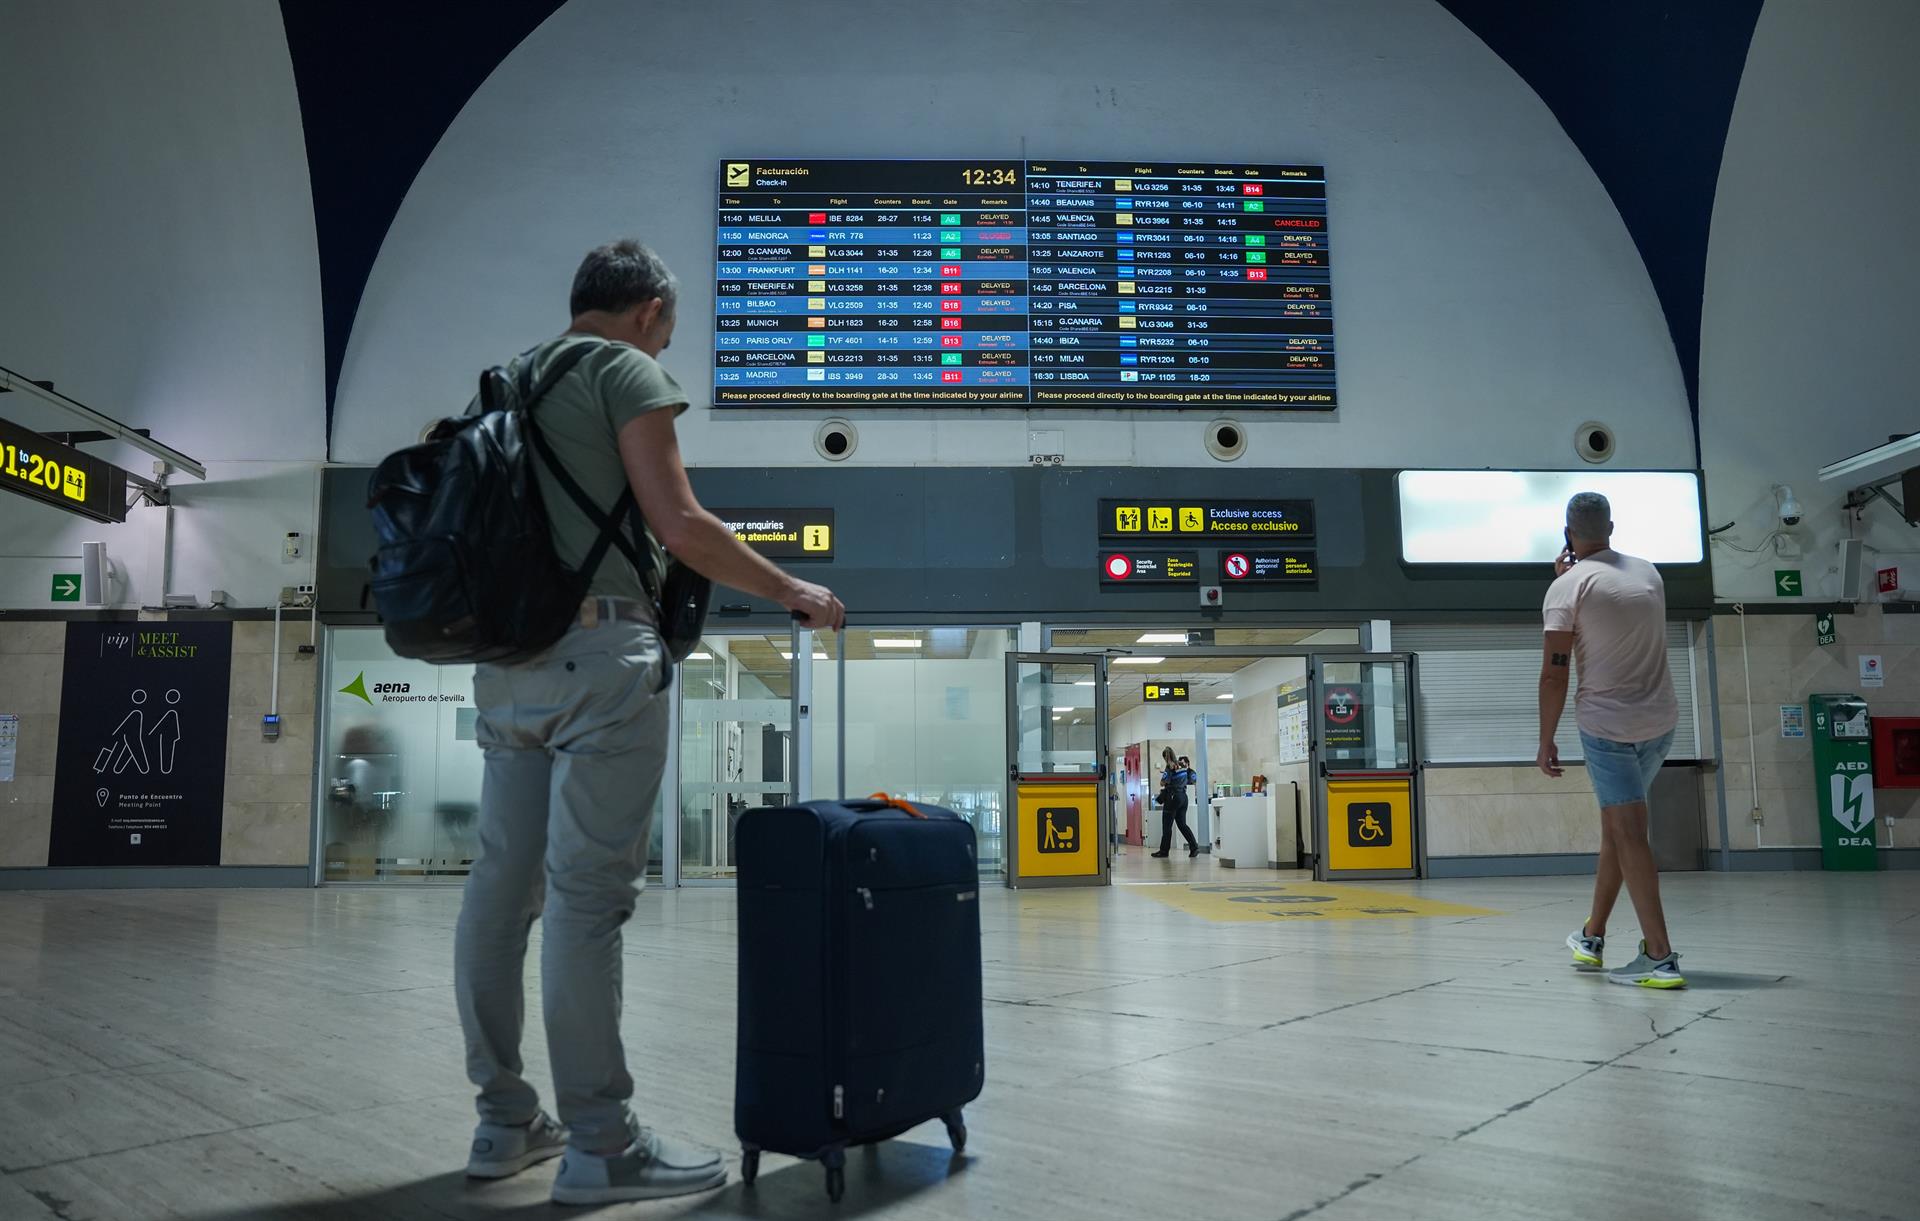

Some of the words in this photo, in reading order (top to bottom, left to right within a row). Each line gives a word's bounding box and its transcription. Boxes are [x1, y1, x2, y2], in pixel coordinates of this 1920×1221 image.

[756, 166, 809, 176] Facturación
[962, 169, 1017, 186] 12:34
[1056, 180, 1102, 188] TENERIFE.N
[829, 198, 848, 206] Flight
[1056, 199, 1095, 207] BEAUVAIS
[1056, 214, 1095, 222] VALENCIA
[748, 232, 789, 240] MENORCA
[828, 232, 846, 240] RYR
[1057, 233, 1098, 241] SANTIAGO
[747, 247, 792, 255] G.CANARIA
[1057, 250, 1104, 258] LANZAROTE
[943, 267, 957, 275] B11
[1057, 267, 1096, 275] VALENCIA
[747, 282, 794, 290] TENERIFE.N
[828, 284, 845, 292] VLG
[1058, 283, 1107, 291] BARCELONA
[1058, 302, 1078, 310] PISA
[1059, 337, 1080, 345] IBIZA
[746, 353, 796, 361] BARCELONA
[1059, 355, 1084, 363] MILAN
[944, 373, 959, 381] B11
[1140, 373, 1155, 381] TAP
[749, 392, 780, 401] proceed
[782, 392, 811, 400] directly
[836, 392, 870, 400] boarding
[871, 392, 889, 400] gate
[968, 392, 978, 400] by
[1037, 391, 1063, 399] Please
[1064, 392, 1095, 400] proceed
[1096, 392, 1125, 400] directly
[1149, 392, 1183, 401] boarding
[1185, 393, 1201, 402] gate
[1243, 393, 1278, 401] indicated
[1278, 393, 1288, 402] by
[1289, 394, 1307, 402] your
[1307, 393, 1331, 401] airline
[19, 449, 29, 463] to
[20, 469, 27, 480] a
[28, 454, 61, 490] 20
[1210, 508, 1250, 519] Exclusive
[1252, 510, 1282, 519] access
[746, 520, 784, 531] enquiries
[1210, 521, 1249, 531] Acceso
[1251, 520, 1299, 531] exclusivo
[747, 532, 787, 542] atención
[788, 532, 797, 541] al
[107, 632, 129, 649] vip
[139, 632, 180, 645] MEET
[1819, 635, 1834, 644] DEA
[373, 683, 411, 694] aena
[382, 694, 426, 703] Aeropuerto
[427, 694, 438, 702] de
[439, 694, 465, 702] Sevilla
[1835, 761, 1869, 771] AED
[1838, 837, 1872, 846] DEA
